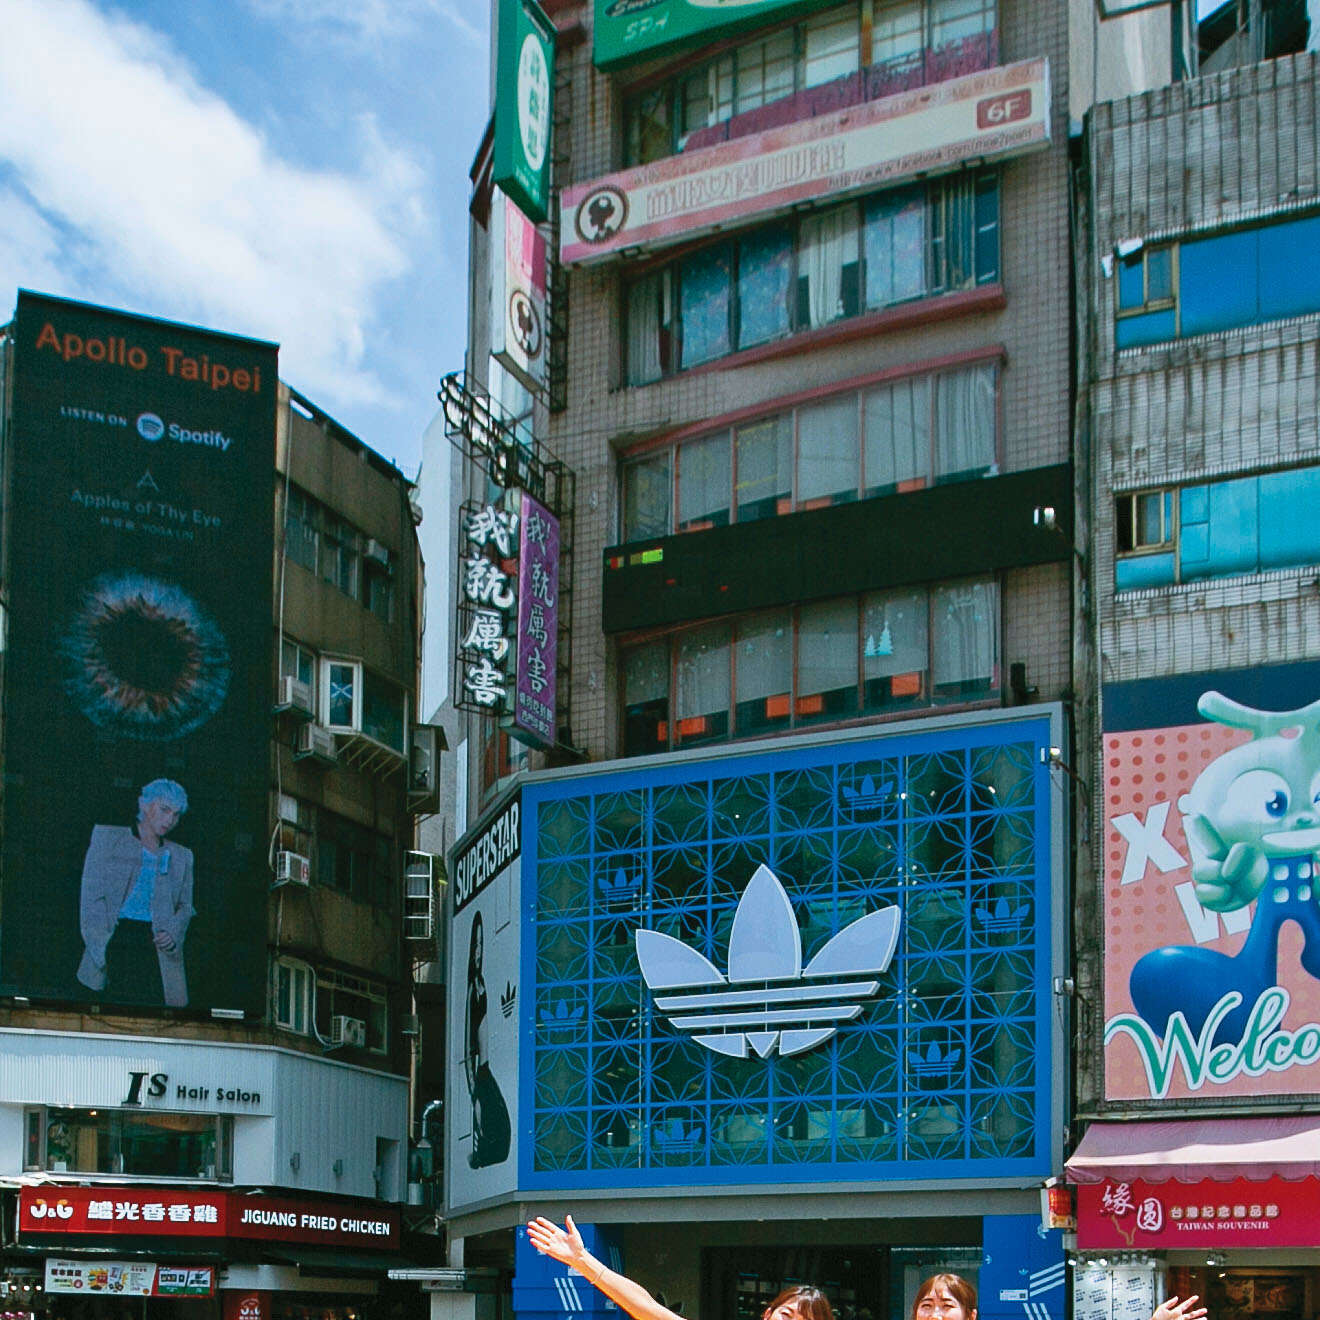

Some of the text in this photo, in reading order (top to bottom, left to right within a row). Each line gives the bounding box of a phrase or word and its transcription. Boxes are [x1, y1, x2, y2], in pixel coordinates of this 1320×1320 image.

[987, 95, 1021, 122] 6F
[35, 321, 261, 392] Apollo Taipei
[60, 405, 231, 451] LISTEN ON Spotify
[71, 488, 222, 527] Apples of Thy Eye
[456, 801, 519, 906] SUPERSTAR
[121, 1071, 261, 1105] IS Hair Salon
[87, 1200, 218, 1224] 繼光香香雞
[241, 1208, 390, 1236] JIGUANG FRIED CHICKEN
[1170, 1205, 1280, 1220] 台灣紀念禮品館
[1176, 1220, 1270, 1231] TAIWAN SOUVENIR
